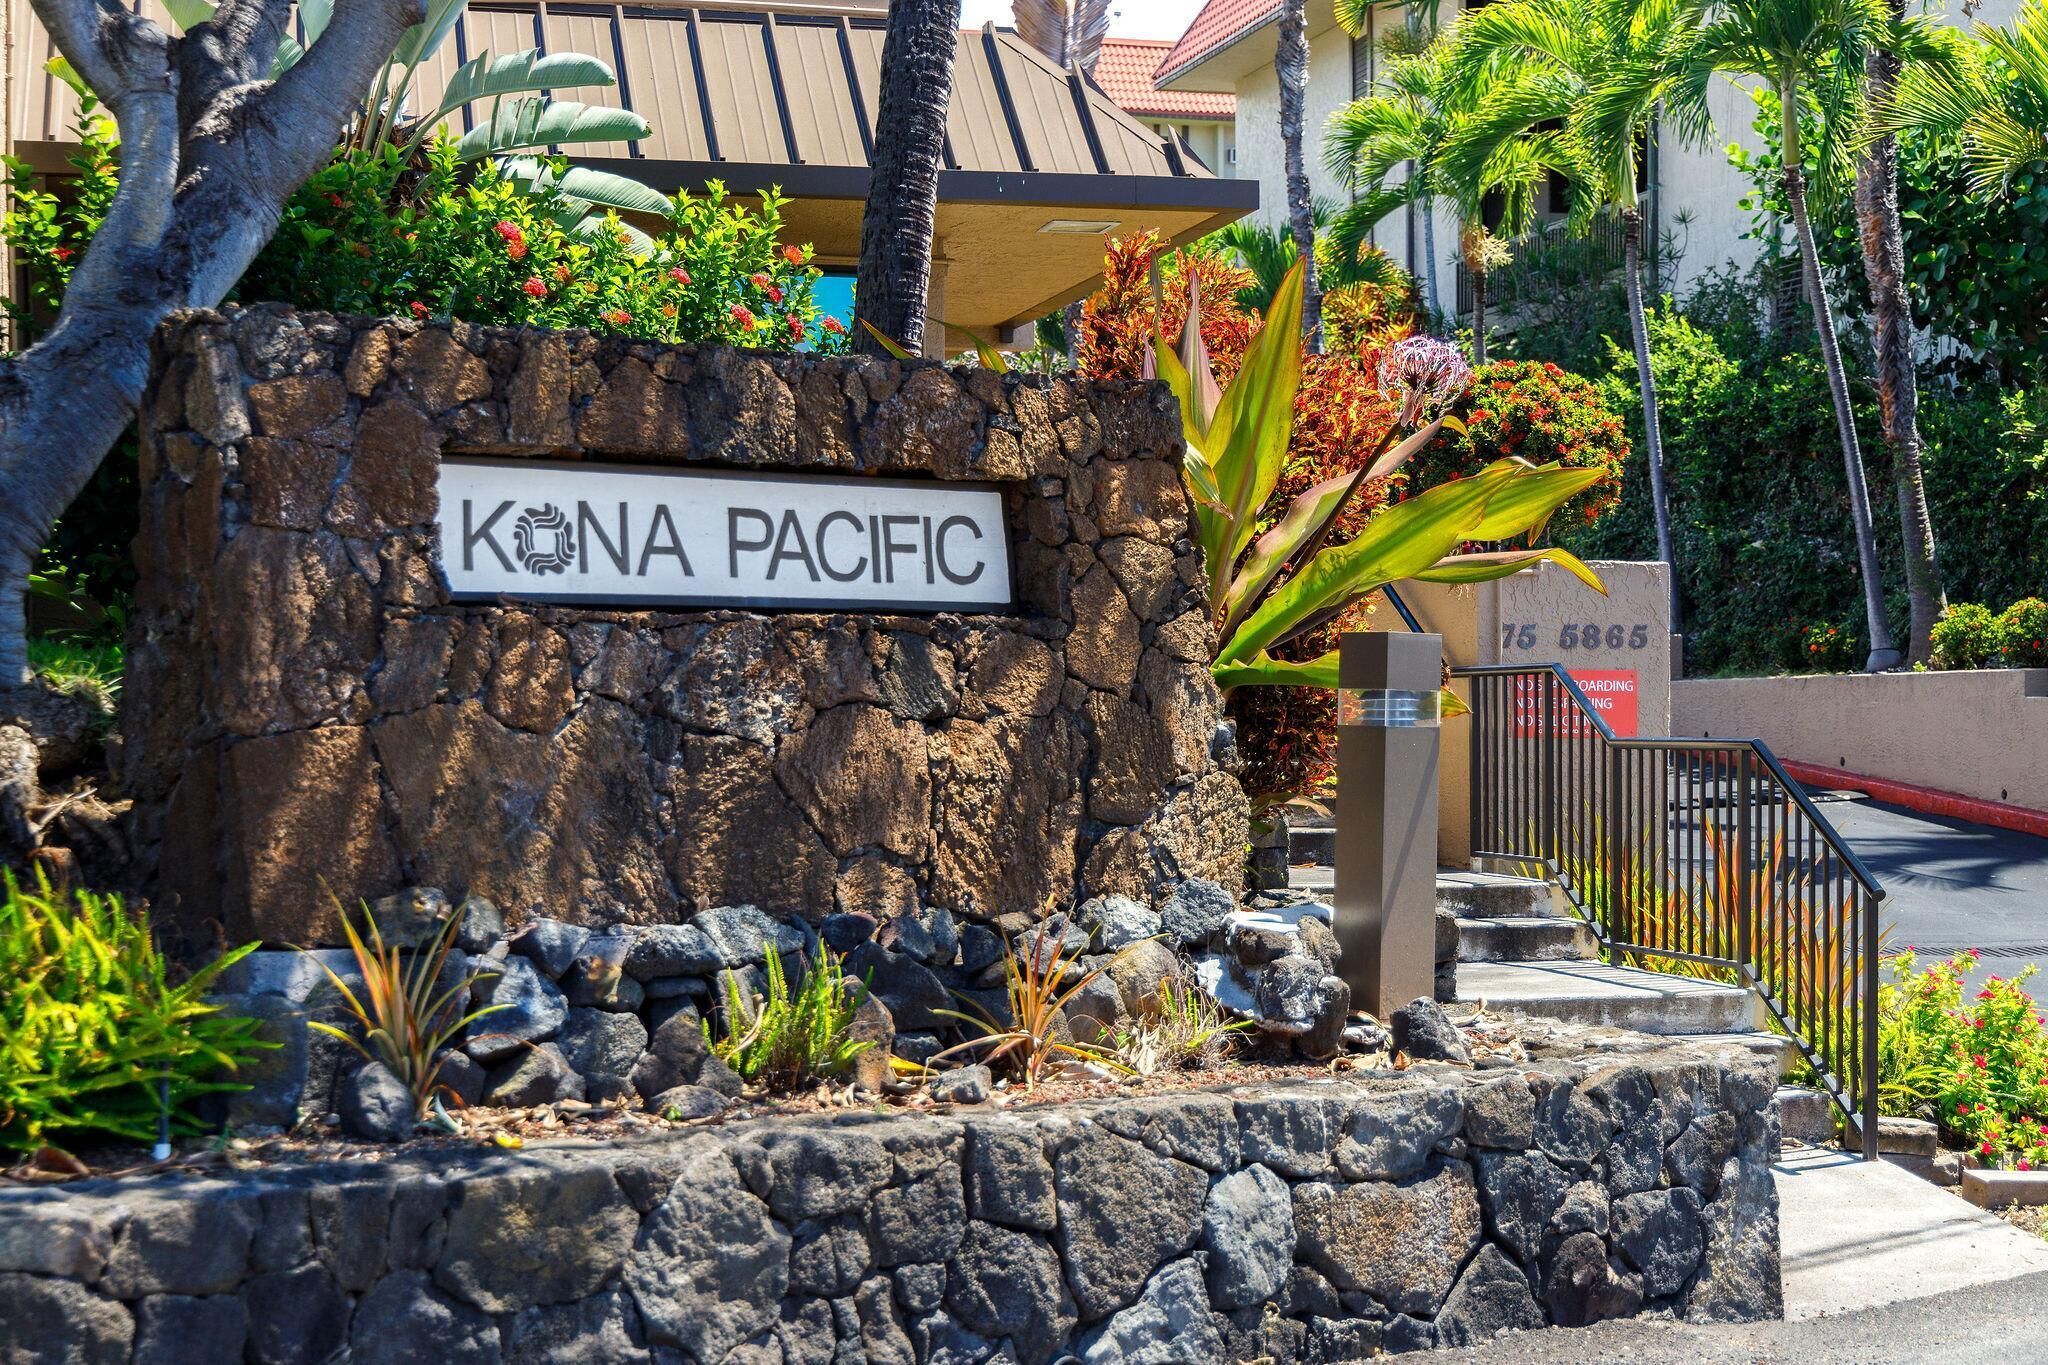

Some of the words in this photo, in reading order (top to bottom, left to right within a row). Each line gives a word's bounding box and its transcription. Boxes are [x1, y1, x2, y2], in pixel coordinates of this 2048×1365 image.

[728, 506, 986, 586] PACIFIC
[1502, 622, 1537, 650] 75
[1559, 622, 1649, 651] 5865
